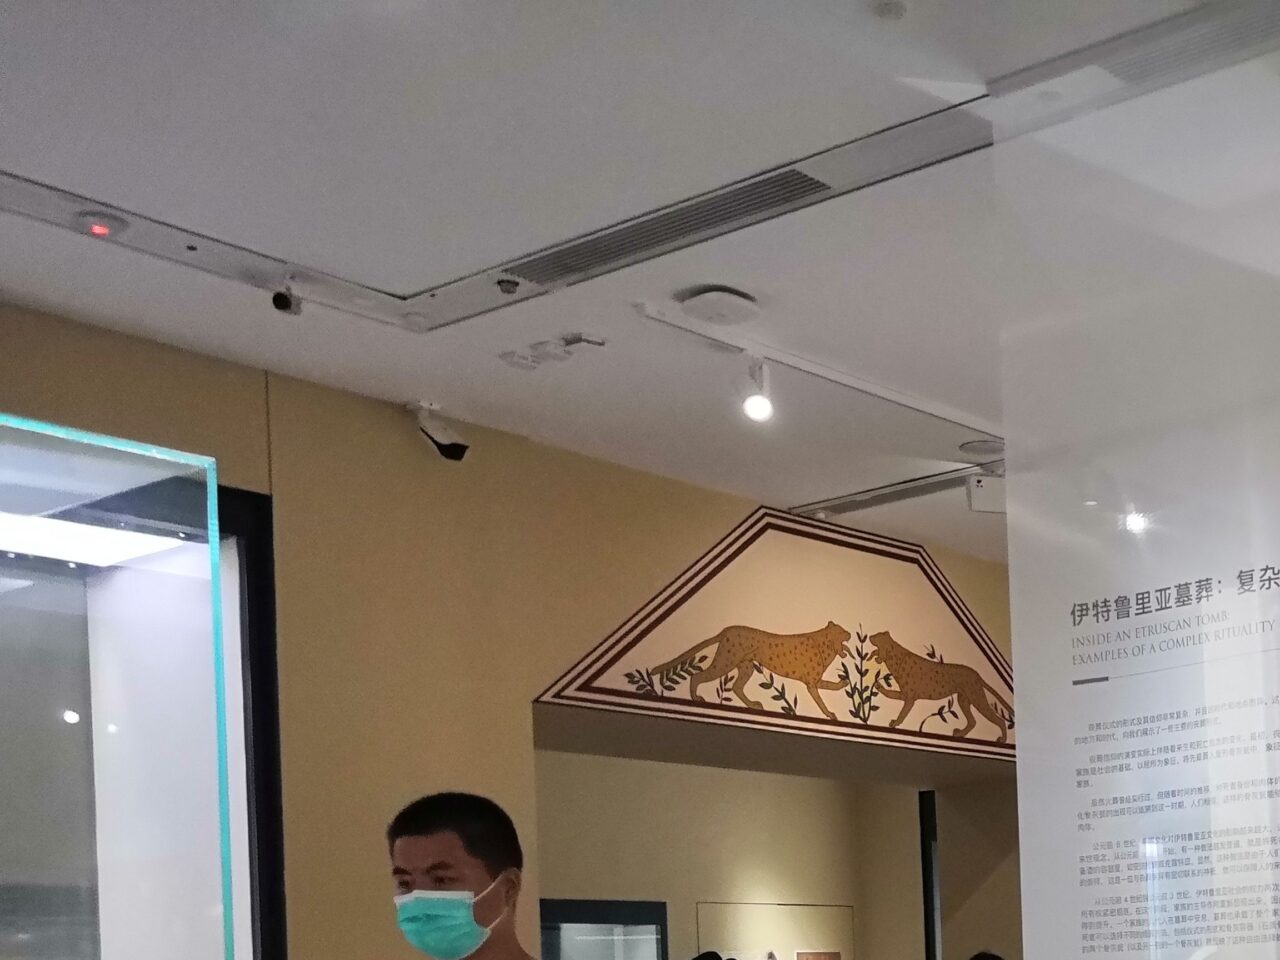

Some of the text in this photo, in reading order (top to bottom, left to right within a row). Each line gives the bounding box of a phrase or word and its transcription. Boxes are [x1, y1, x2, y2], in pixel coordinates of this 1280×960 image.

[1071, 629, 1112, 649] INSIDE
[1115, 628, 1132, 643] AN
[1135, 617, 1192, 640] ETRUSCAN
[1072, 619, 1275, 665] EXAMPLES OF A COMPLEX RITUALITY
